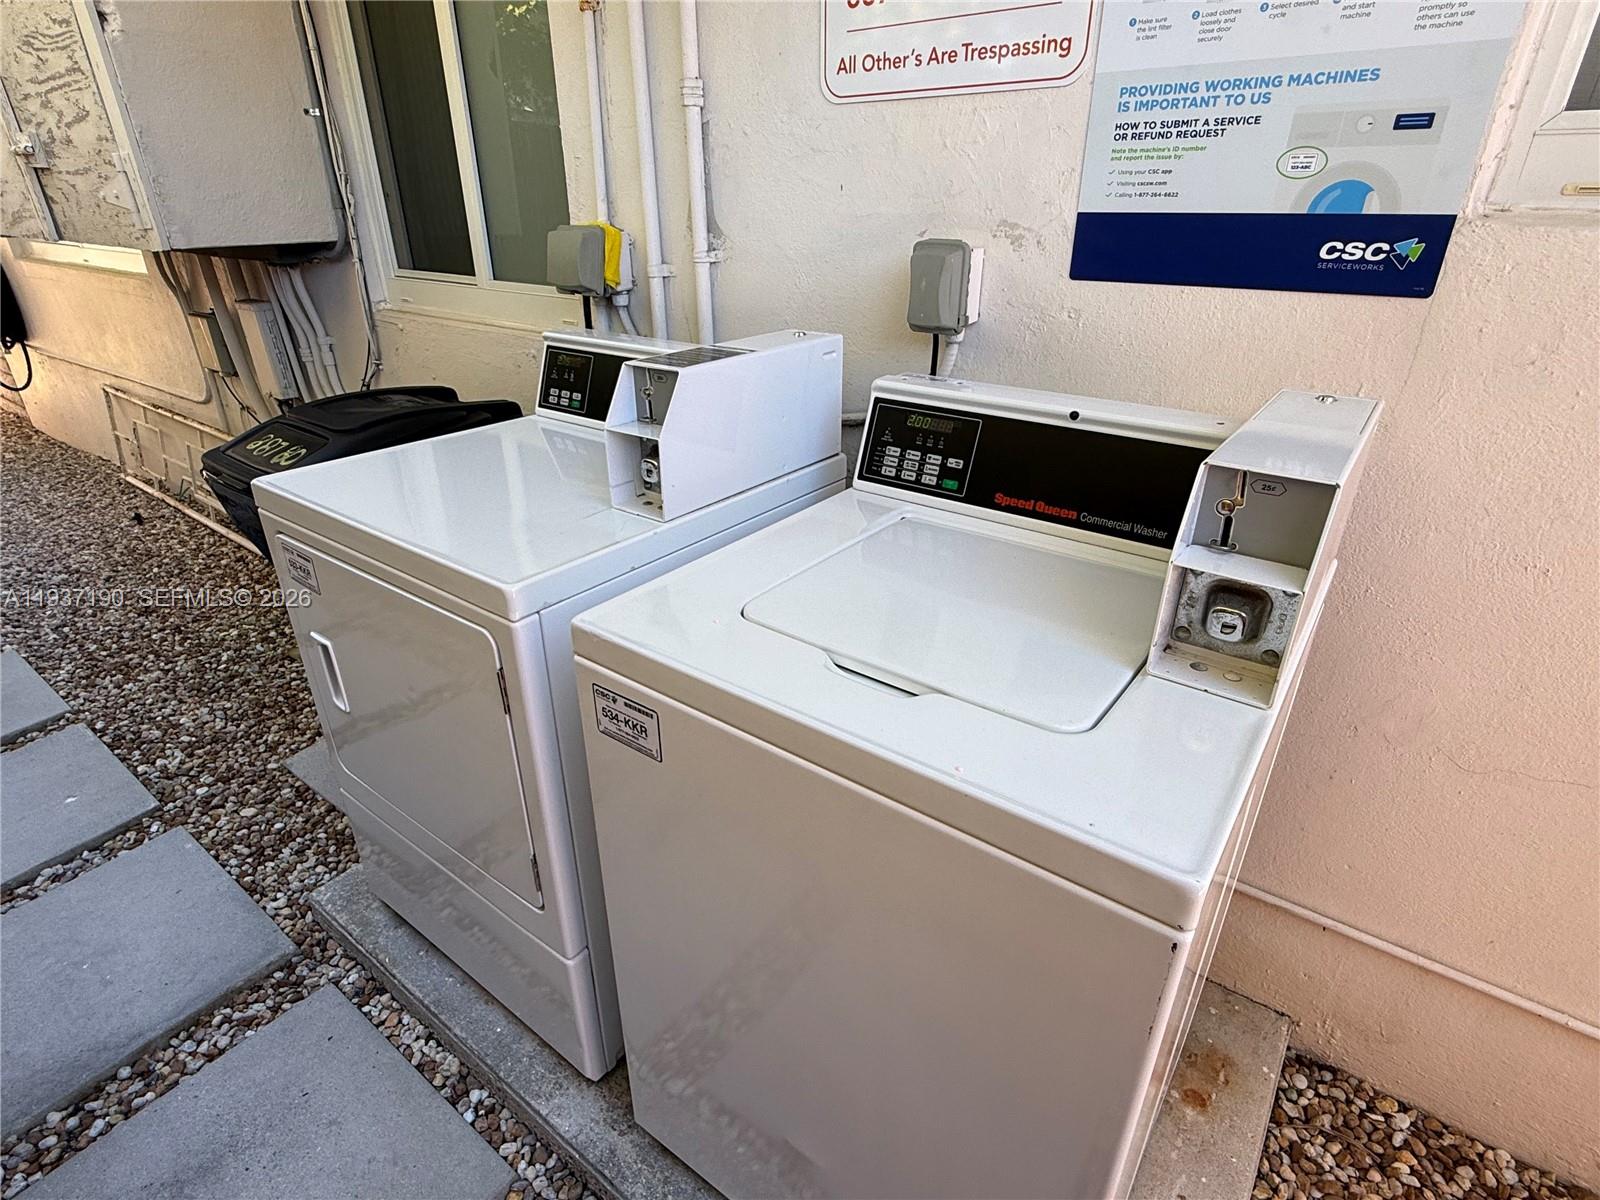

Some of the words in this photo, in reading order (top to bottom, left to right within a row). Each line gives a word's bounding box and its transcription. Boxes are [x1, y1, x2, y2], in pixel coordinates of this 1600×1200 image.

[1271, 3, 1292, 11] Select
[1342, 3, 1357, 11] and
[1358, 1, 1376, 9] start
[1419, 2, 1455, 13] promptly
[1219, 8, 1242, 16] clothes
[1268, 11, 1286, 20] cycle
[1340, 11, 1371, 20] machine
[1416, 13, 1441, 22] others
[1460, 9, 1476, 17] use
[1138, 18, 1153, 26] Make
[1200, 18, 1222, 27] loosely
[1414, 23, 1426, 31] the
[1429, 20, 1463, 30] machine
[1158, 24, 1172, 32] filter
[1198, 27, 1215, 35] close
[1216, 25, 1232, 33] door
[1141, 33, 1157, 41] clean
[1197, 35, 1223, 44] securely
[836, 54, 857, 75] All
[861, 48, 923, 72] Other's
[926, 46, 958, 66] Are
[961, 33, 1073, 64] Trespassing
[1119, 81, 1200, 99] PROVIDING
[1205, 75, 1283, 93] WORKING
[1287, 67, 1381, 88] MACHINES
[1117, 101, 1130, 113] IS
[1134, 95, 1220, 112] IMPORTANT
[1224, 93, 1245, 107] TO
[1250, 92, 1272, 105] US
[1115, 121, 1142, 132] HOW
[1143, 120, 1158, 130] TO
[1159, 118, 1200, 129] SUBMIT
[1202, 117, 1211, 128] A
[1213, 115, 1262, 127] SERVICE
[1113, 132, 1129, 142] OR
[1130, 130, 1173, 141] REFUND
[1175, 128, 1226, 140] REQUEST
[1139, 146, 1171, 154] machine's
[1180, 145, 1207, 153] number
[1123, 155, 1143, 163] report
[1155, 153, 1172, 161] issue
[1173, 153, 1184, 161] by:
[1318, 241, 1391, 262] CSC
[1316, 262, 1385, 272] SERVICEWORKS
[994, 492, 1035, 511] Speed
[1035, 501, 1078, 520] Queen
[1079, 511, 1132, 533] Commercial
[1133, 523, 1169, 541] Washer
[601, 706, 649, 738] 534-KKR
